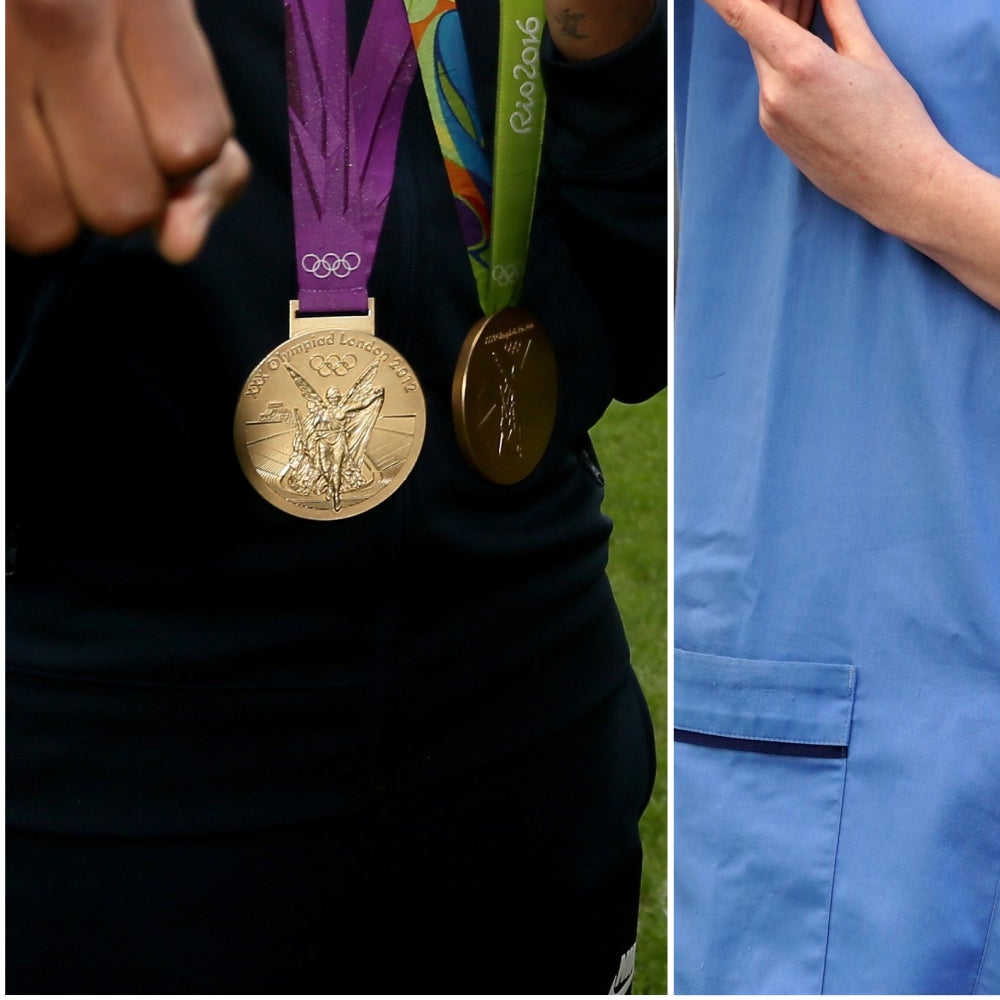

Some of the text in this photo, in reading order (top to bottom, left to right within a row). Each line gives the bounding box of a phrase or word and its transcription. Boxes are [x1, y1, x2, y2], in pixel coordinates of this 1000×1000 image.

[267, 333, 335, 371] Olympiad
[338, 332, 390, 362] London
[388, 358, 417, 394] 2012
